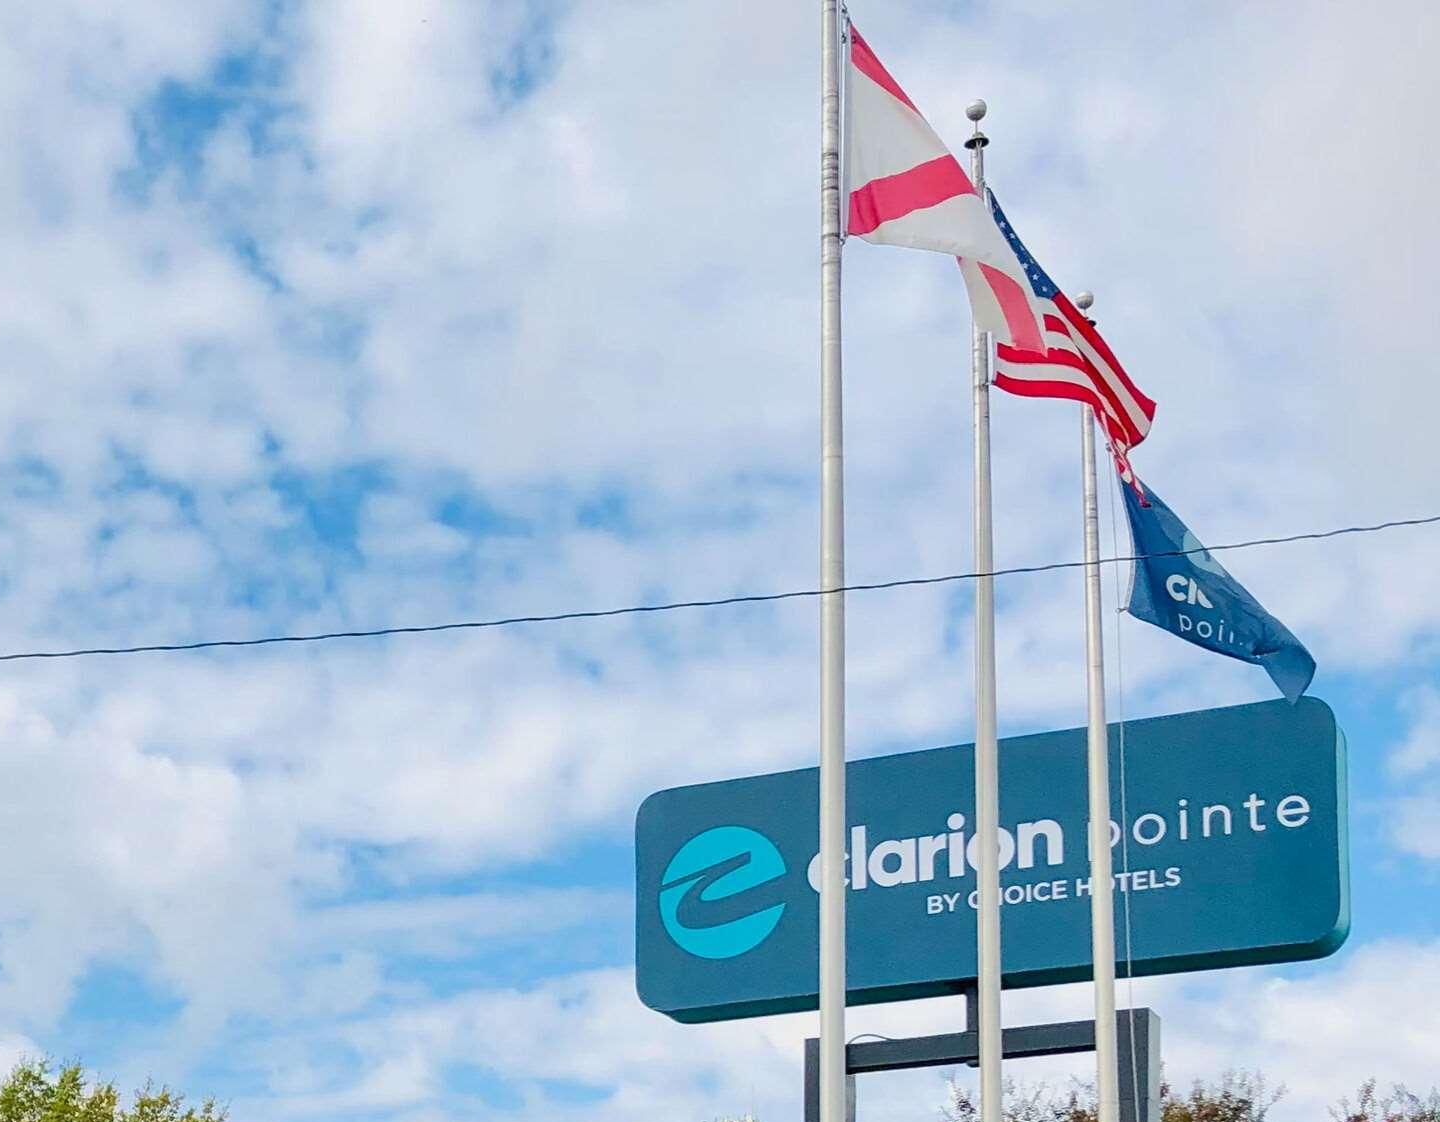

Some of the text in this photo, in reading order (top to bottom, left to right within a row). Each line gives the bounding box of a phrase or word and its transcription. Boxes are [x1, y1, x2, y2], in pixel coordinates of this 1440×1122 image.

[927, 867, 1181, 914] BY COICE HTELS
